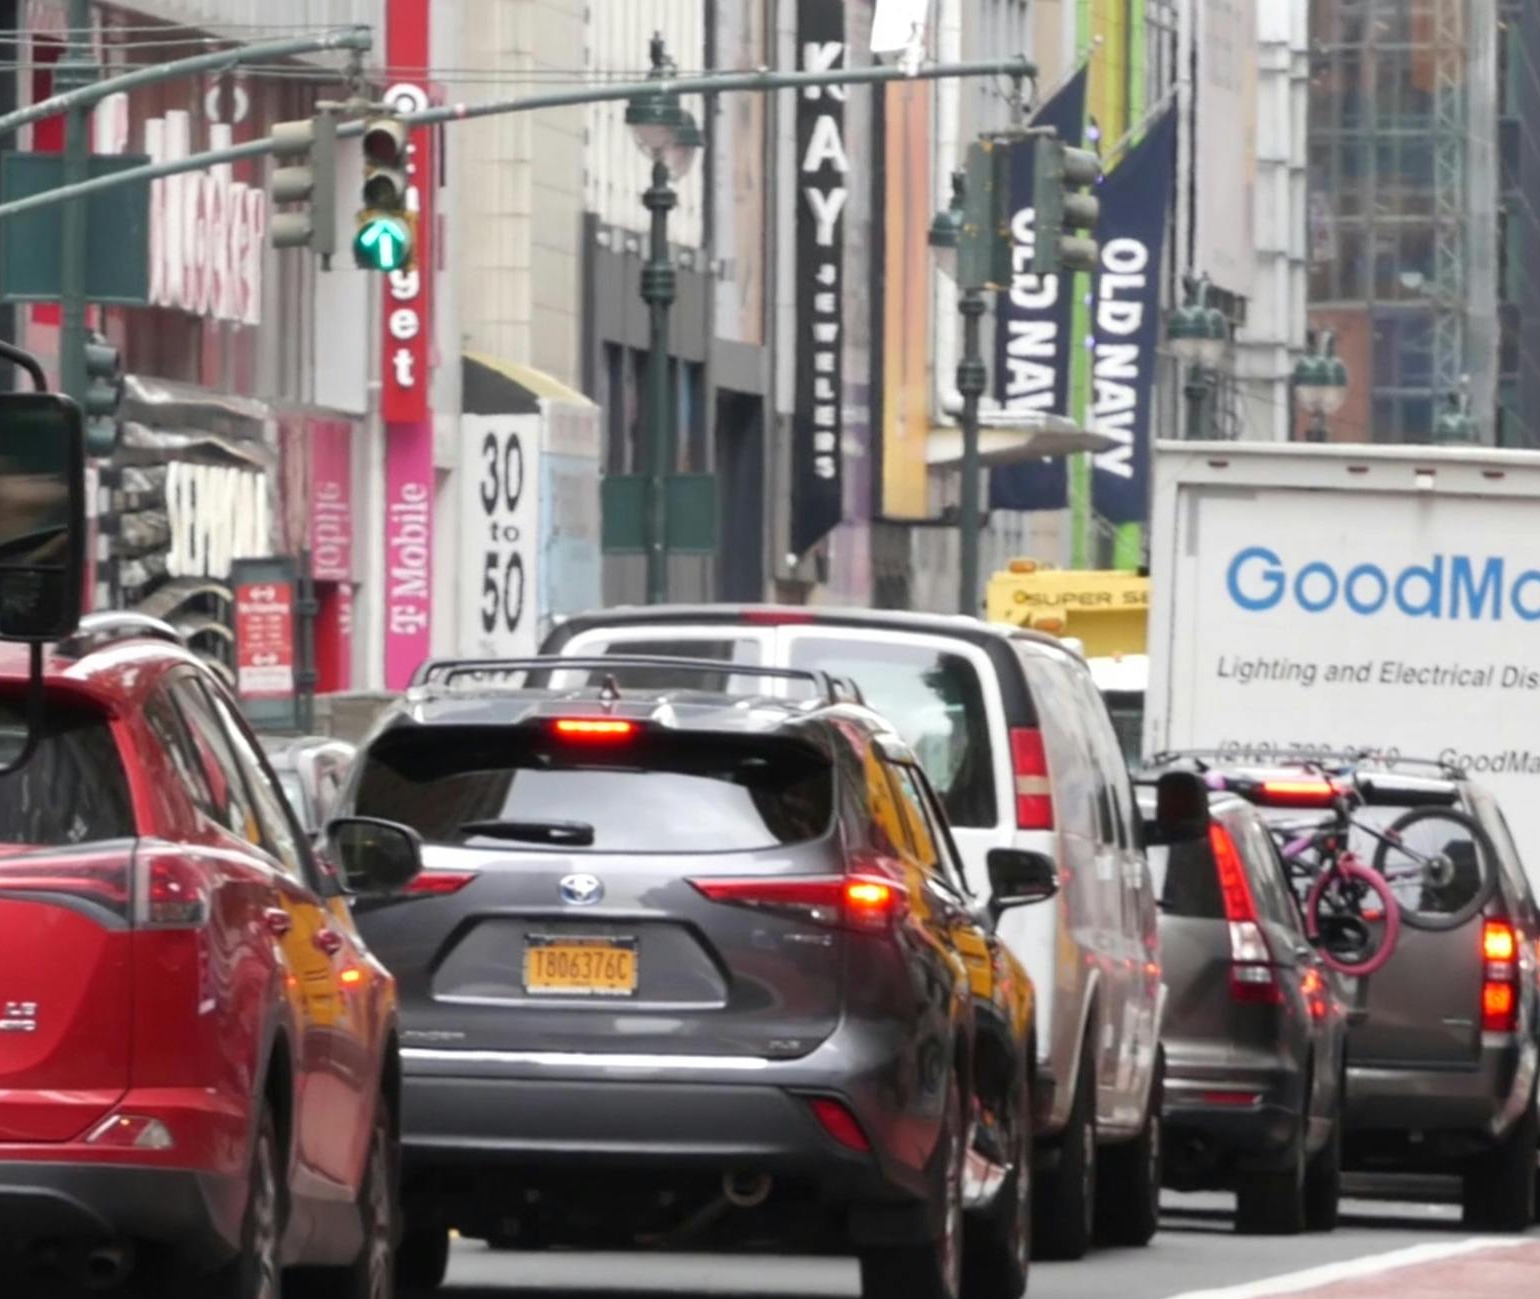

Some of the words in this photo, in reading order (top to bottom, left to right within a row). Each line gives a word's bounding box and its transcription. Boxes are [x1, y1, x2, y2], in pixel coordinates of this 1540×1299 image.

[803, 41, 848, 245] KAY
[1096, 237, 1149, 335] OLD
[814, 263, 838, 478] JEWELERS
[1094, 344, 1139, 480] NAVY
[481, 432, 524, 516] 30
[490, 522, 519, 542] to
[482, 551, 524, 633] 50
[1217, 656, 1317, 686] Lighting
[1324, 661, 1372, 684] and
[1379, 661, 1494, 688] Electrical
[534, 950, 628, 981] T806376C
